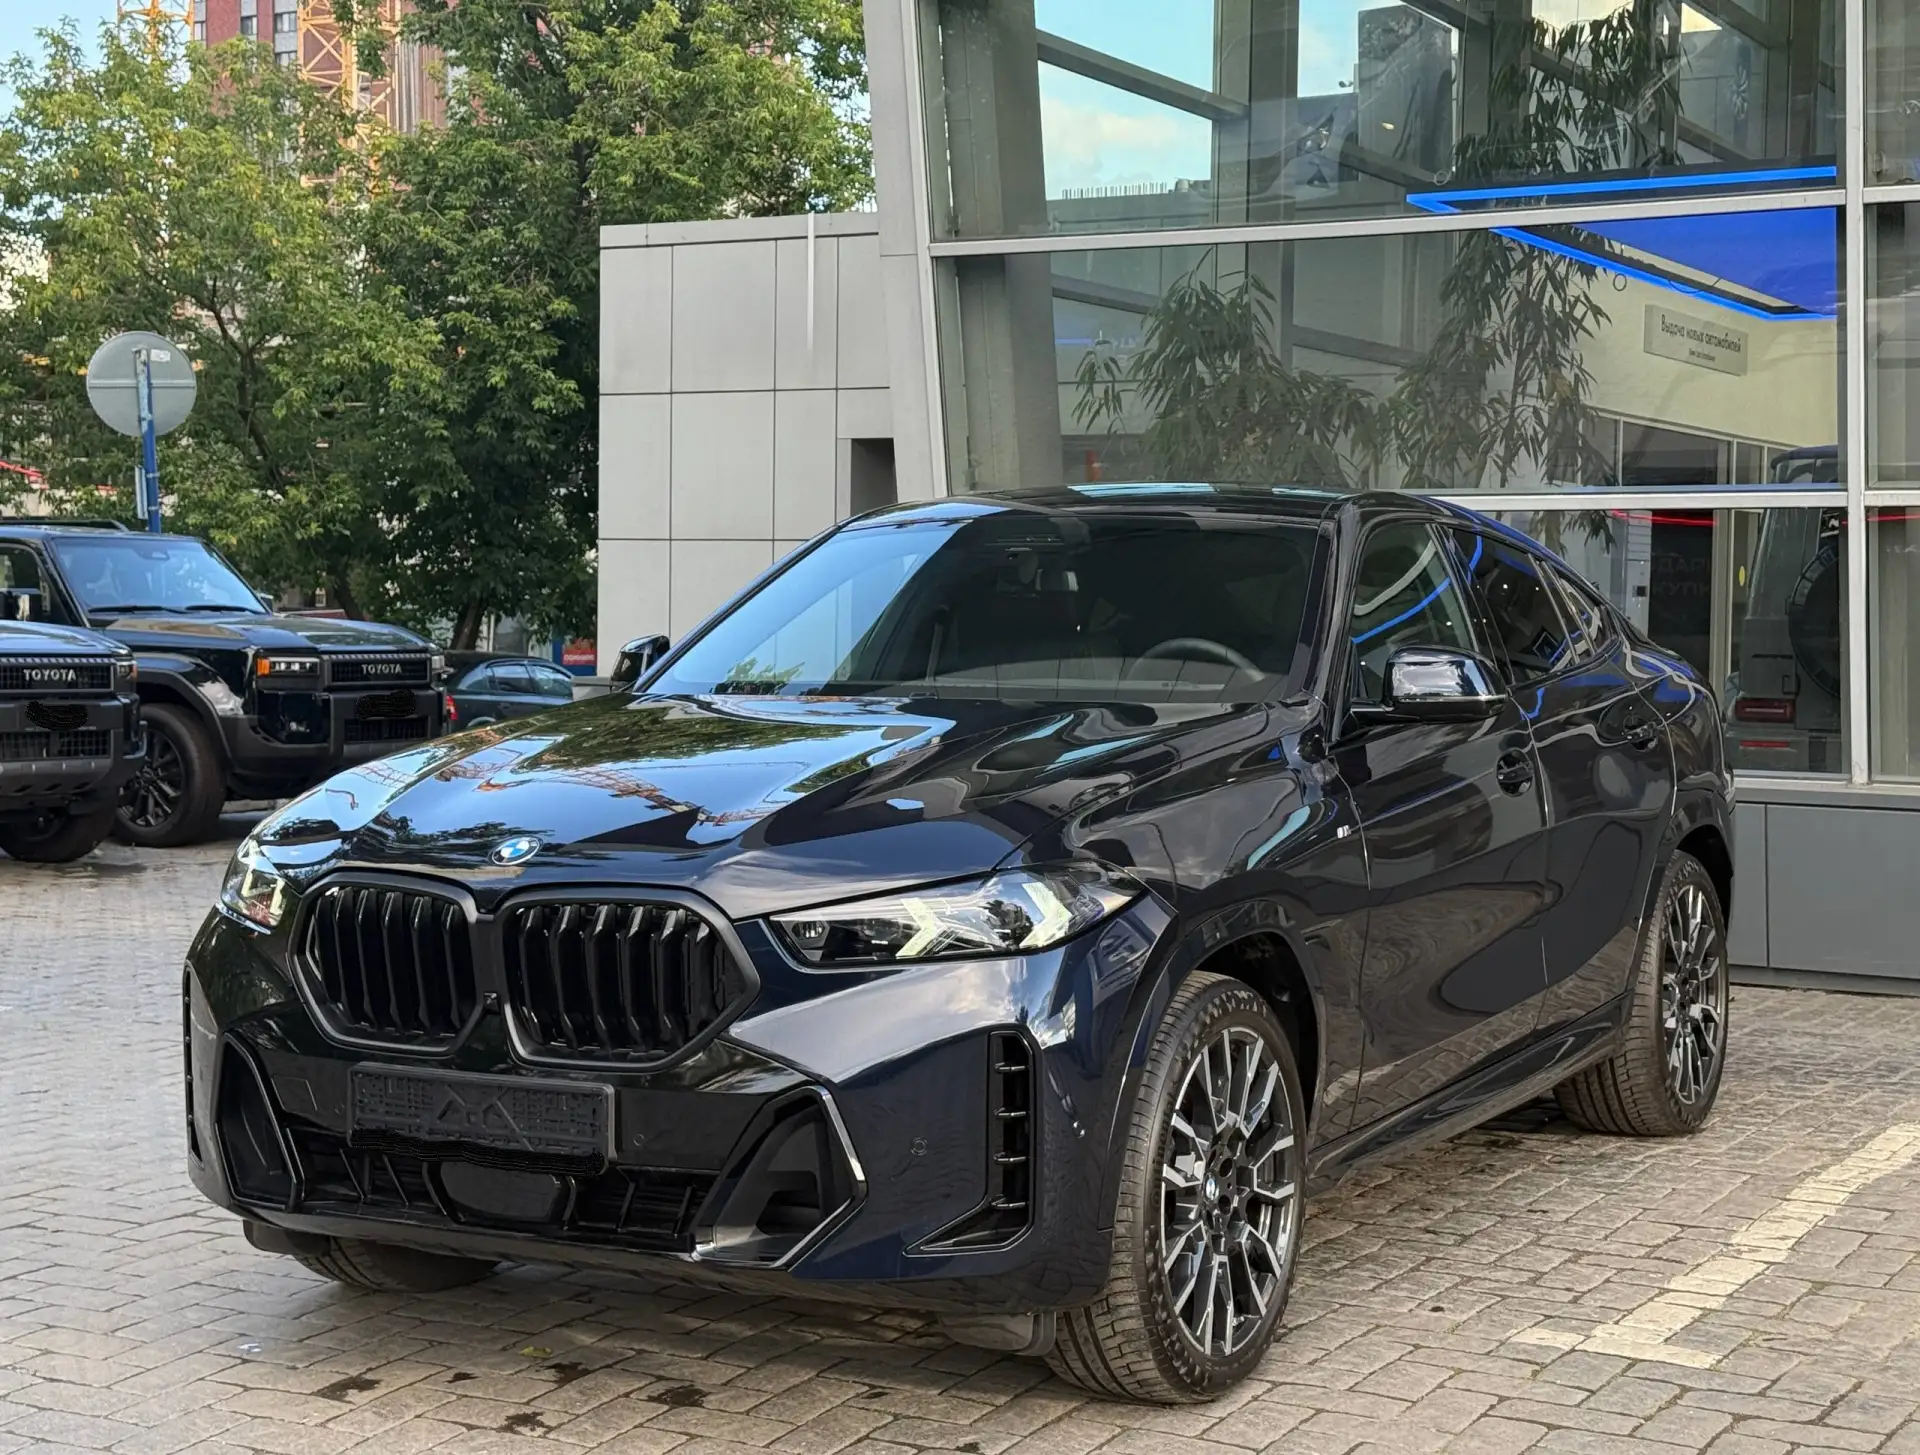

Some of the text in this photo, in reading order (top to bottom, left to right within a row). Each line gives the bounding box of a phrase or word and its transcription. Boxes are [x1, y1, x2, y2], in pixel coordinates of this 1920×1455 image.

[1661, 314, 1685, 338] Выдача
[1686, 327, 1704, 344] новых
[23, 668, 77, 681] TOYOTA
[361, 664, 402, 675] TOYOTA
